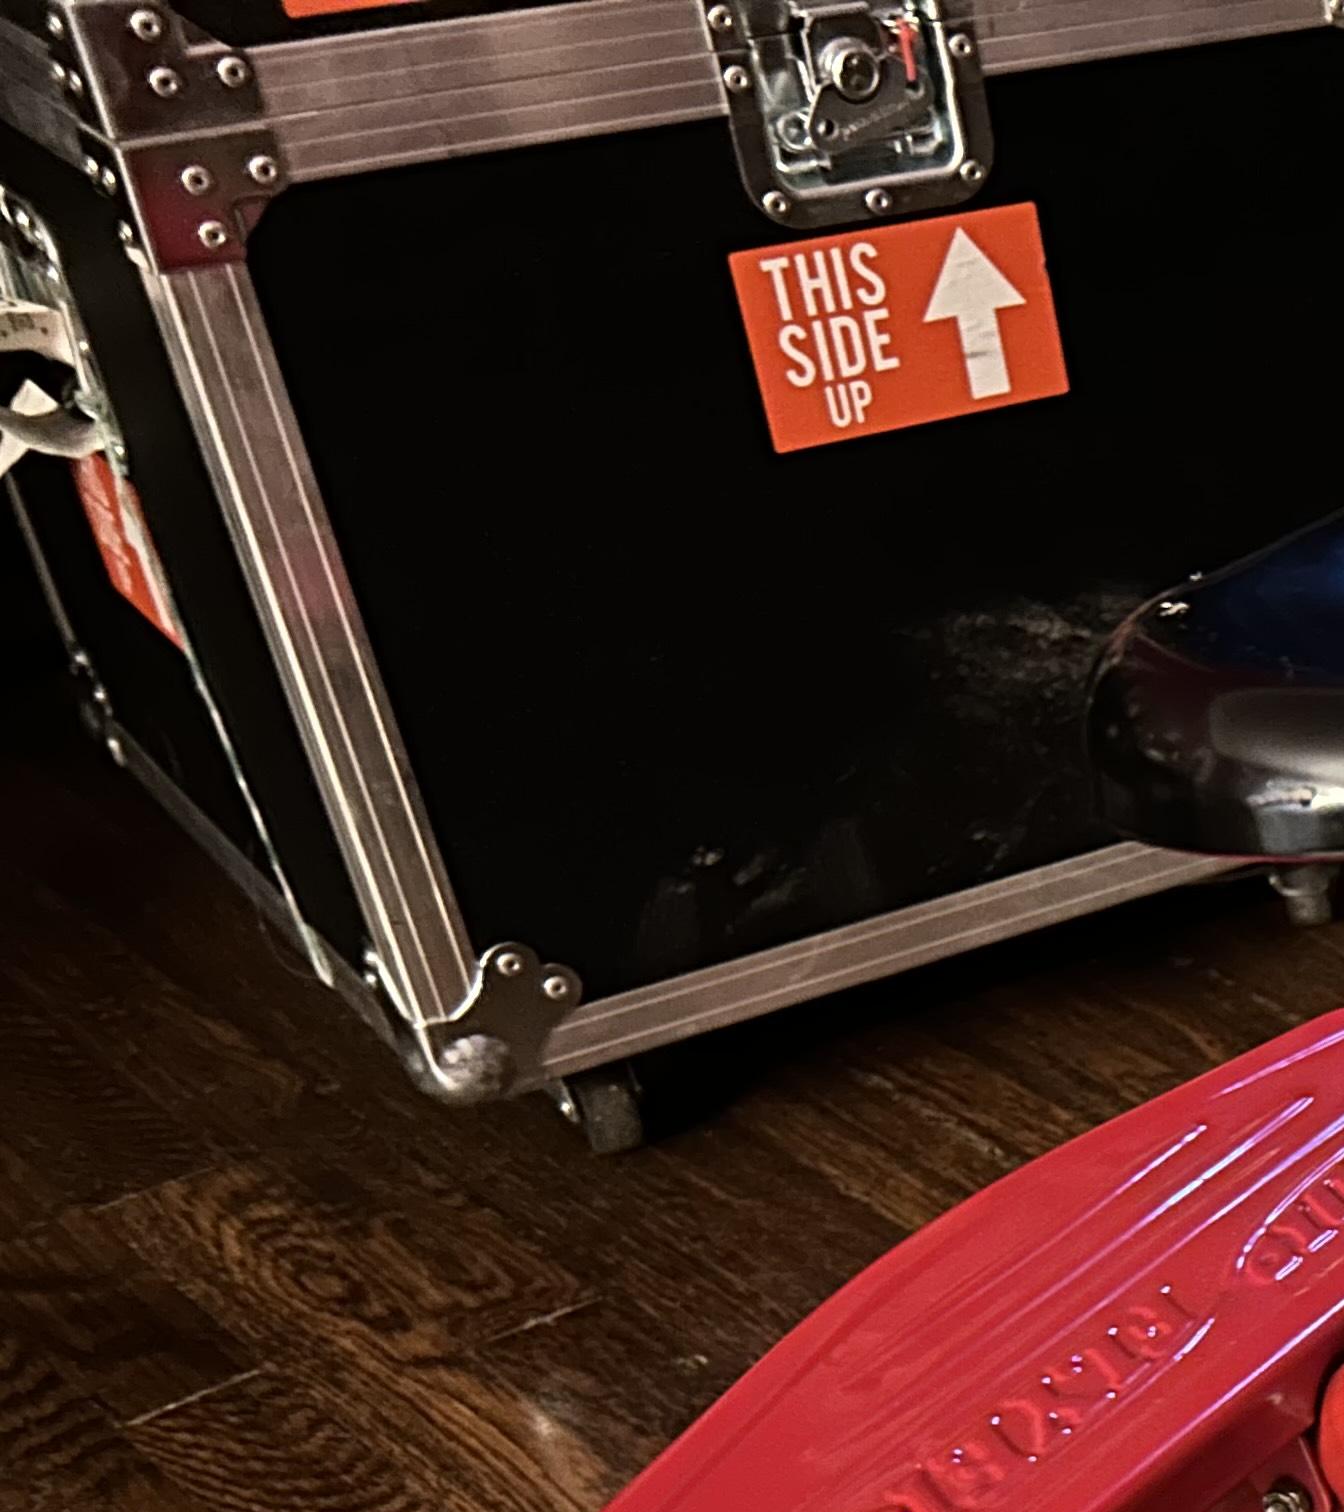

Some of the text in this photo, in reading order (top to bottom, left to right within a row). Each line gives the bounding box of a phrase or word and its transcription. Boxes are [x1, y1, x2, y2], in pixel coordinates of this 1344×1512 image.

[760, 242, 886, 321] THIS
[779, 308, 900, 387] SIDE
[825, 380, 872, 428] UP
